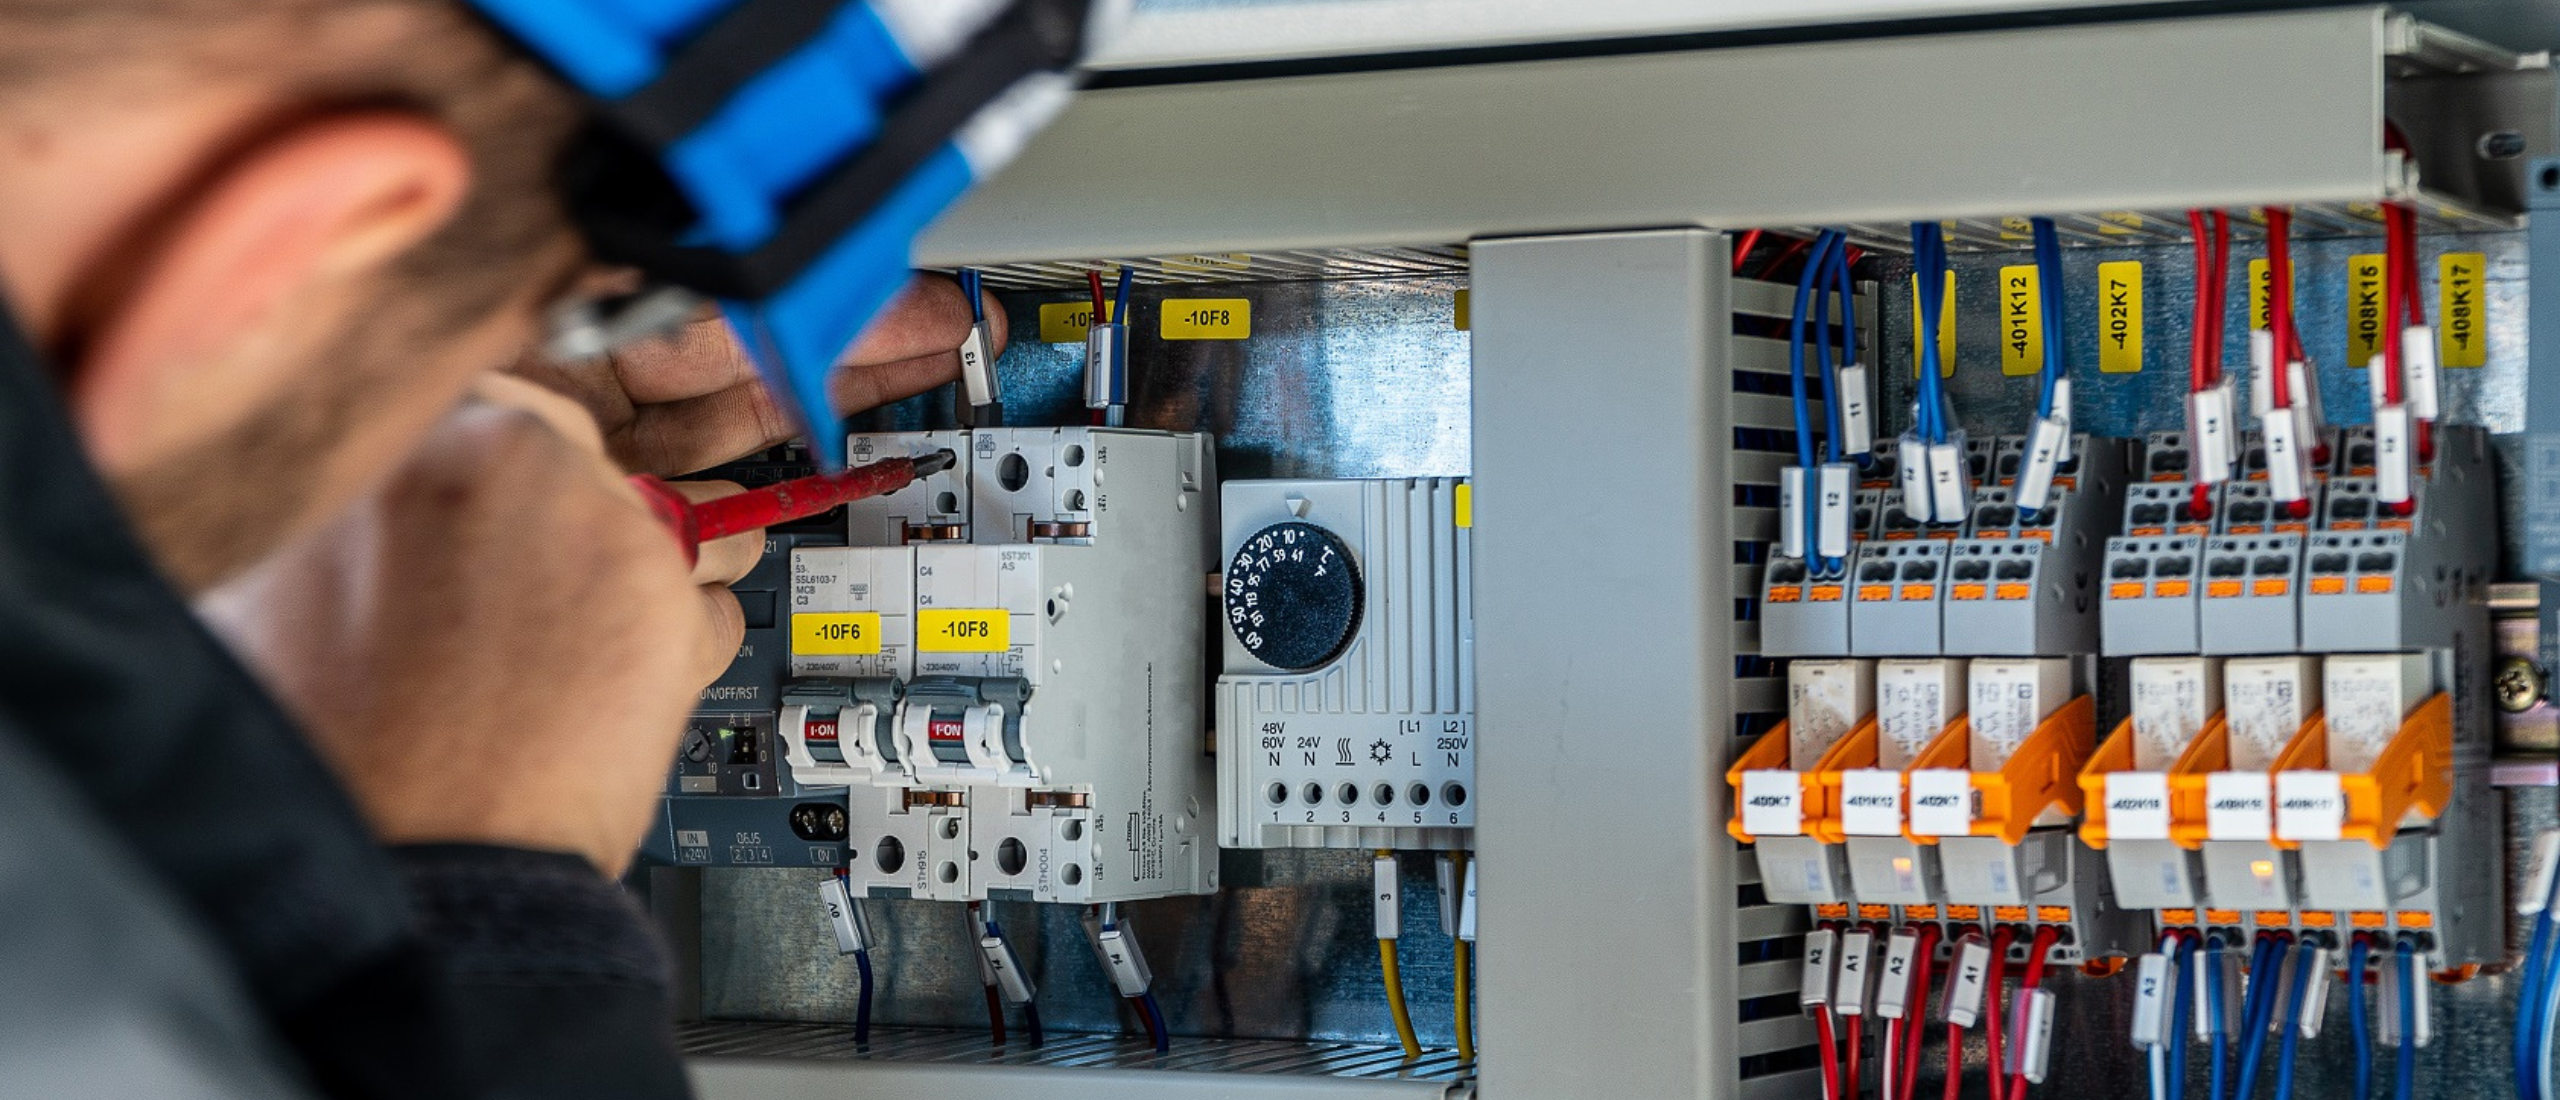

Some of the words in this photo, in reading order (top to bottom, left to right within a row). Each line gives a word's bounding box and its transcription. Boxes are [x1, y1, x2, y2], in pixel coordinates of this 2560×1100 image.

[1063, 313, 1095, 327] -10F
[1184, 312, 1230, 326] -10F8
[2011, 277, 2027, 358] -401K12
[2110, 279, 2127, 350] -402K7
[965, 352, 976, 366] 13
[1256, 535, 1272, 553] 20
[1283, 529, 1295, 545] 10
[1237, 552, 1254, 571] 30
[1273, 549, 1286, 562] 59
[1291, 549, 1304, 563] 41
[919, 566, 933, 576] C4
[1256, 557, 1270, 573] 77
[1247, 573, 1260, 587] 95
[796, 586, 816, 594] MCB
[1230, 579, 1244, 596] 40
[796, 595, 809, 605] C3
[919, 595, 933, 605] C4
[1232, 606, 1247, 624] 50
[815, 623, 860, 640] -10F6
[941, 621, 988, 637] -10F8
[1245, 632, 1263, 650] 60
[700, 686, 759, 700] ON/OFF/RST
[1262, 722, 1285, 734] 48V
[1407, 722, 1420, 733] L1
[1443, 722, 1458, 733] L2
[1262, 737, 1285, 749] 60V
[1297, 737, 1321, 749] 24V
[1437, 737, 1468, 750] 250V
[1269, 753, 1280, 766] N
[1304, 752, 1315, 766] N
[1412, 753, 1421, 766] L
[1448, 753, 1458, 766] N
[707, 762, 718, 774] 10
[1274, 811, 1278, 822] 1
[1306, 811, 1314, 823] 2
[1342, 811, 1350, 823] 3
[1377, 811, 1386, 823] 4
[1414, 812, 1421, 823] 5
[1450, 812, 1458, 824] 6
[687, 834, 699, 844] IN
[917, 850, 927, 889] STH915
[1381, 893, 1391, 901] 3
[1809, 948, 1823, 965] A2
[1846, 954, 1859, 972] A1
[1890, 957, 1905, 975] A2
[1965, 966, 1980, 984] A1
